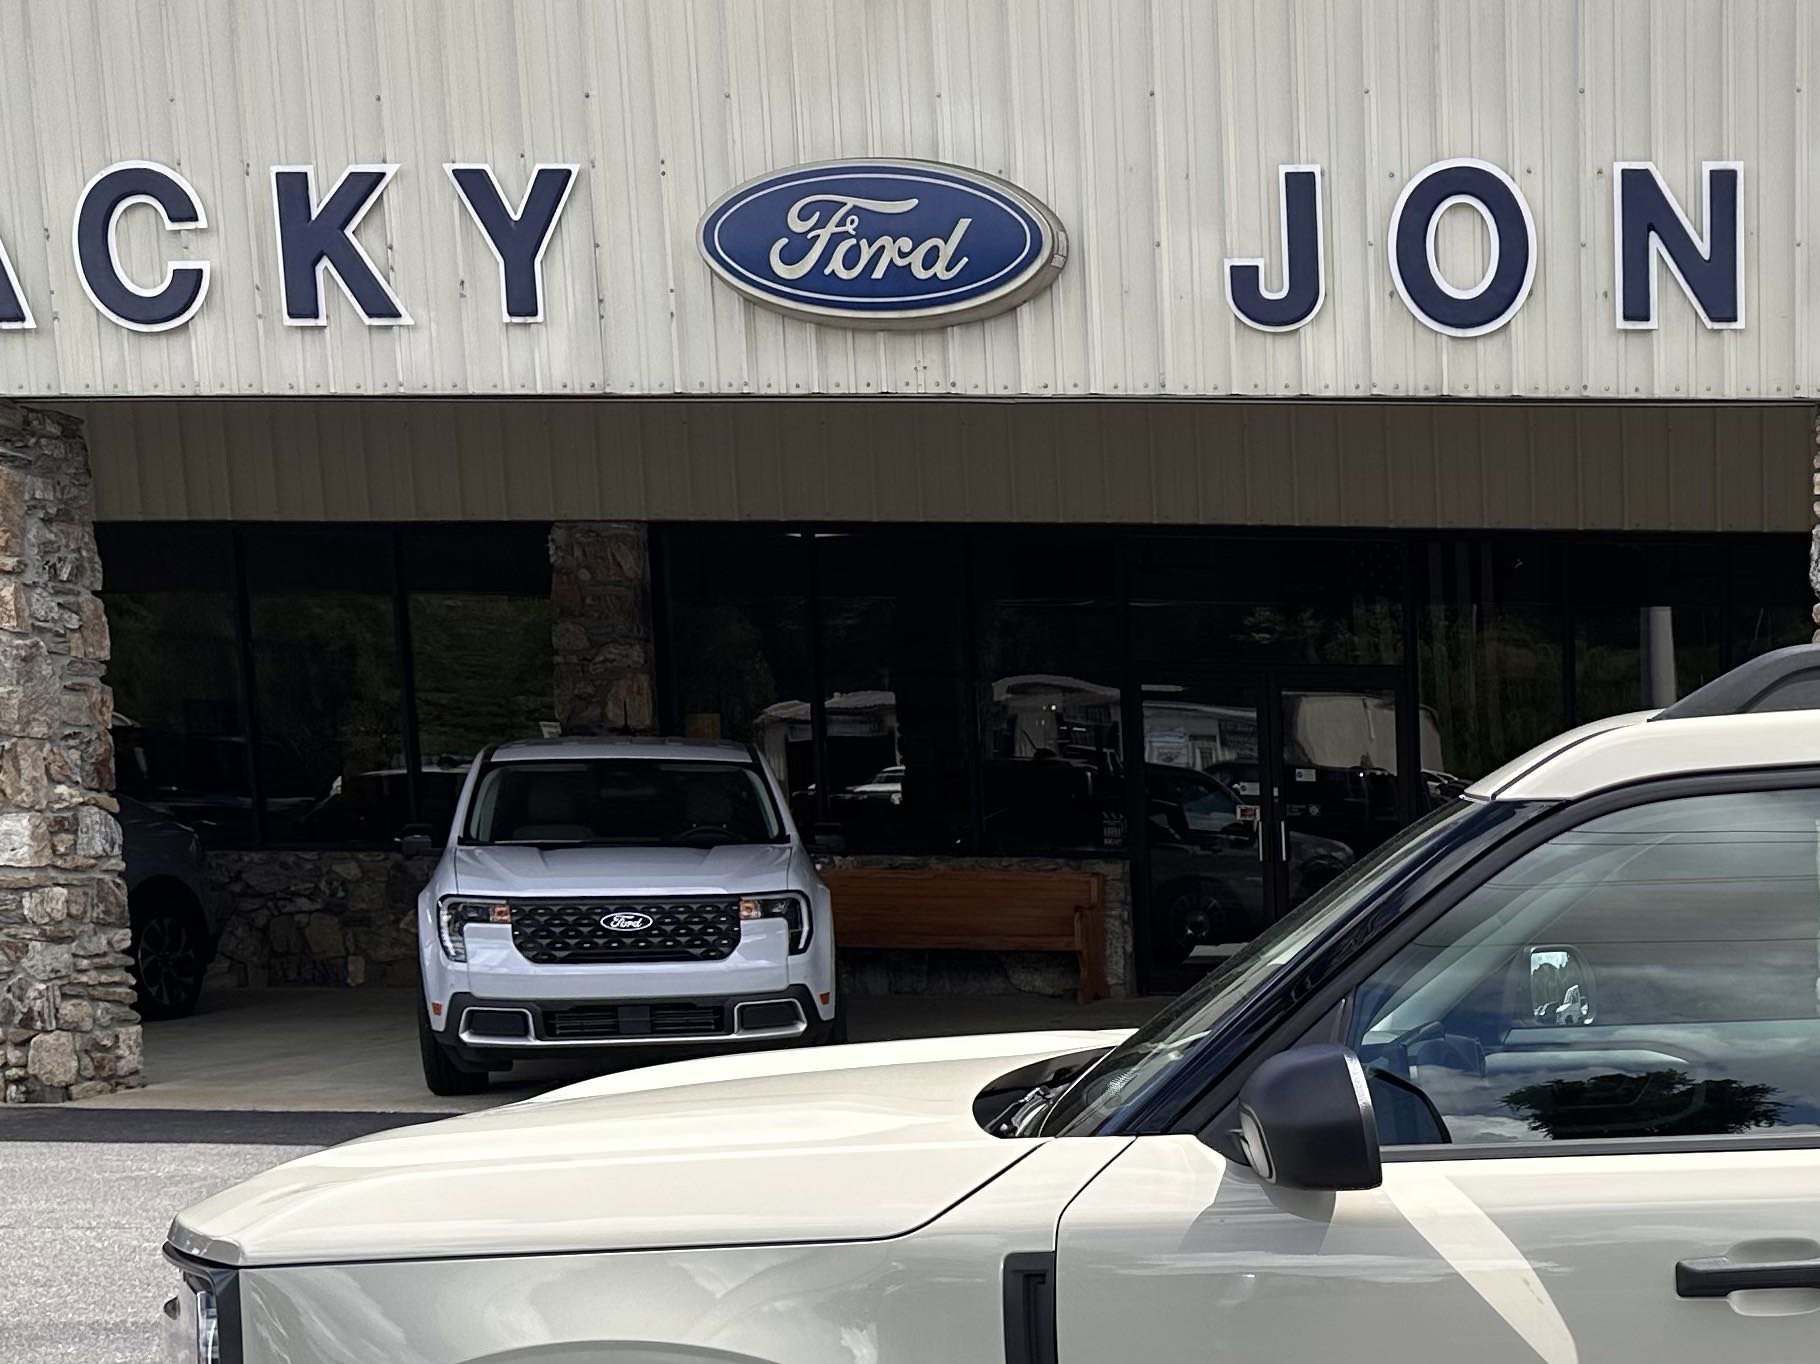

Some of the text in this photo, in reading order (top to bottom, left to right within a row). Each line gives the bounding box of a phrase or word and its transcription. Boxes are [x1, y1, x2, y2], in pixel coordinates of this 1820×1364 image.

[0, 159, 582, 333] CKY
[769, 194, 972, 280] Ford
[610, 914, 643, 928] Ford
